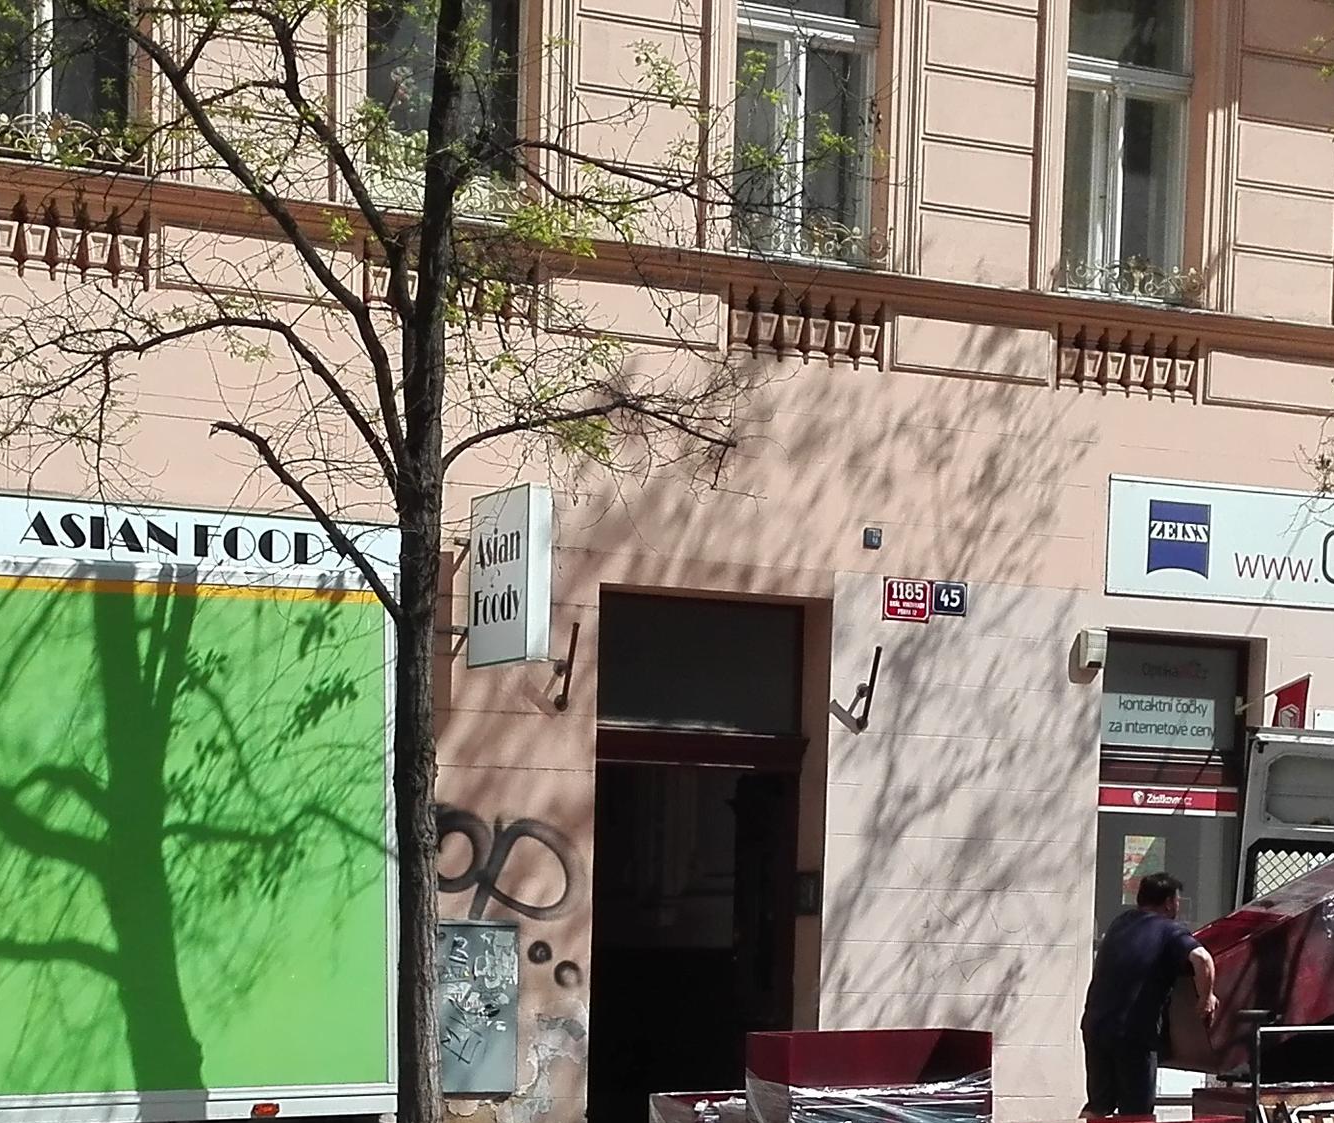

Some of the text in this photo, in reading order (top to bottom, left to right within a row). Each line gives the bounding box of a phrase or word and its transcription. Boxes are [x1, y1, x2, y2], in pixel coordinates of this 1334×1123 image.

[19, 510, 179, 556] ASIAN
[1149, 520, 1209, 543] ZEISS
[474, 528, 521, 570] Asian
[891, 582, 924, 600] 1185
[939, 588, 961, 607] 45
[473, 584, 523, 626] Foody
[1118, 695, 1209, 718] kontaktní čočky
[1108, 720, 1216, 739] za internetové ceny
